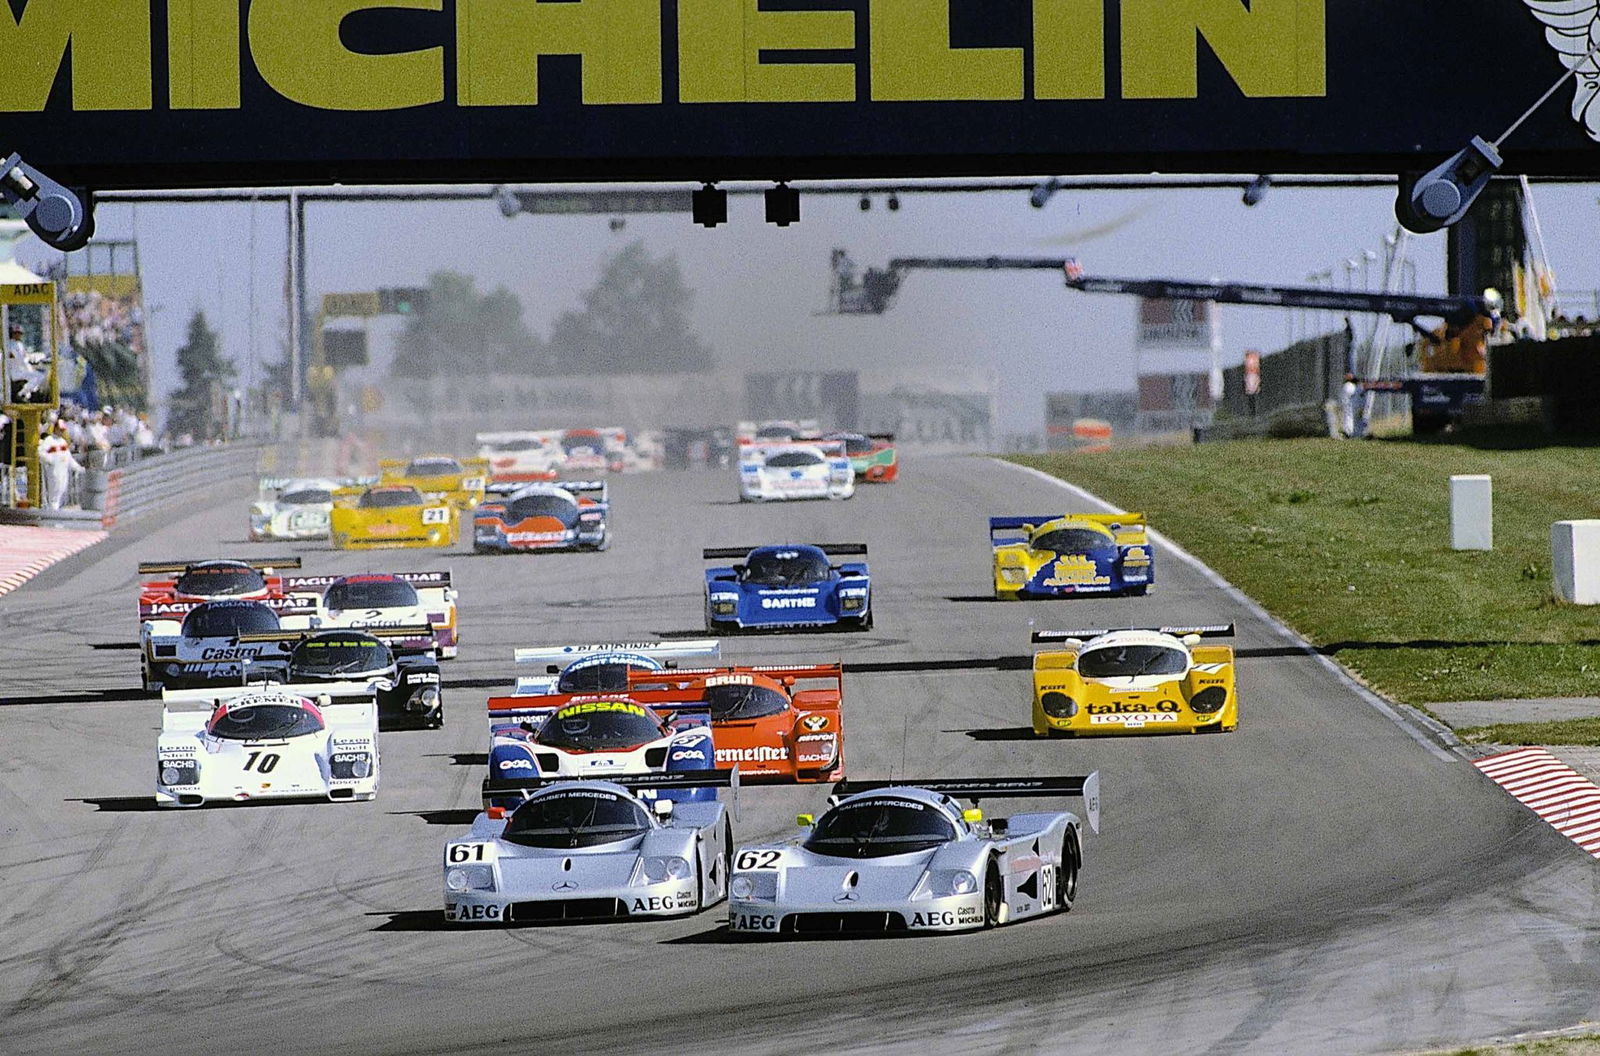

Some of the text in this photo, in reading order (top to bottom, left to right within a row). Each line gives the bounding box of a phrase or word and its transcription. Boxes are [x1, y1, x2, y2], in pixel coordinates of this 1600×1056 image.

[0, 0, 1327, 111] MICHELIN
[14, 283, 49, 295] ADAC
[428, 510, 444, 520] 21
[289, 576, 336, 587] JAGU
[150, 602, 197, 614] JAGU
[761, 597, 817, 609] SARTHE
[201, 646, 263, 661] Castrol
[705, 675, 753, 687] BRUN
[228, 698, 301, 710] KREMER
[1085, 700, 1182, 714] taka-Q
[558, 702, 646, 719] NISSAN
[1096, 714, 1173, 722] TOYOTA
[334, 753, 366, 762] SACHS
[716, 746, 789, 762] rmeister
[798, 753, 831, 761] SACHS
[163, 760, 195, 768] SACHS
[243, 751, 280, 773] 10
[532, 791, 617, 803] SAUBER MERCEDES
[874, 800, 924, 810] MERCEDES
[449, 844, 484, 863] 61
[737, 851, 781, 870] 62
[632, 895, 674, 912] AEG
[459, 904, 500, 920] AEG
[737, 914, 776, 930] AEG
[910, 911, 955, 926] AEG
